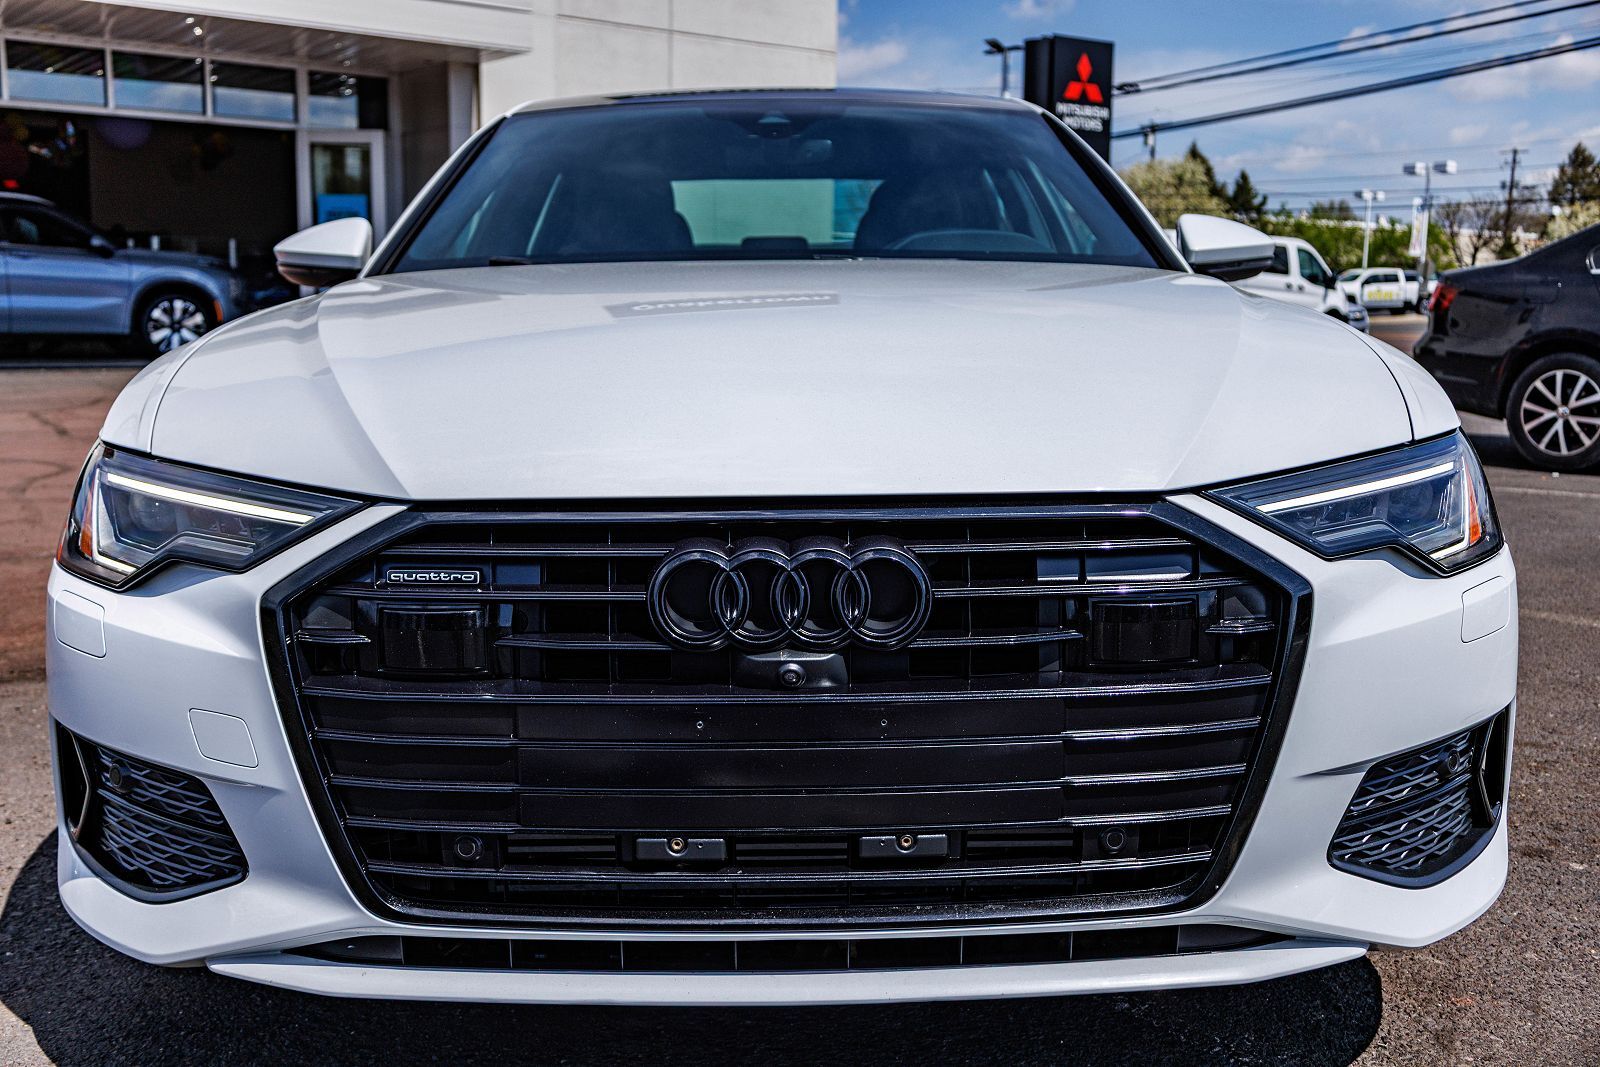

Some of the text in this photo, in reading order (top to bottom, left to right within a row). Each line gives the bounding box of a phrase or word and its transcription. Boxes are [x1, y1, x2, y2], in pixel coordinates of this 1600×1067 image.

[1057, 103, 1109, 119] MITSUBISHI
[1062, 115, 1103, 132] MOTORS
[390, 572, 475, 582] quattro
